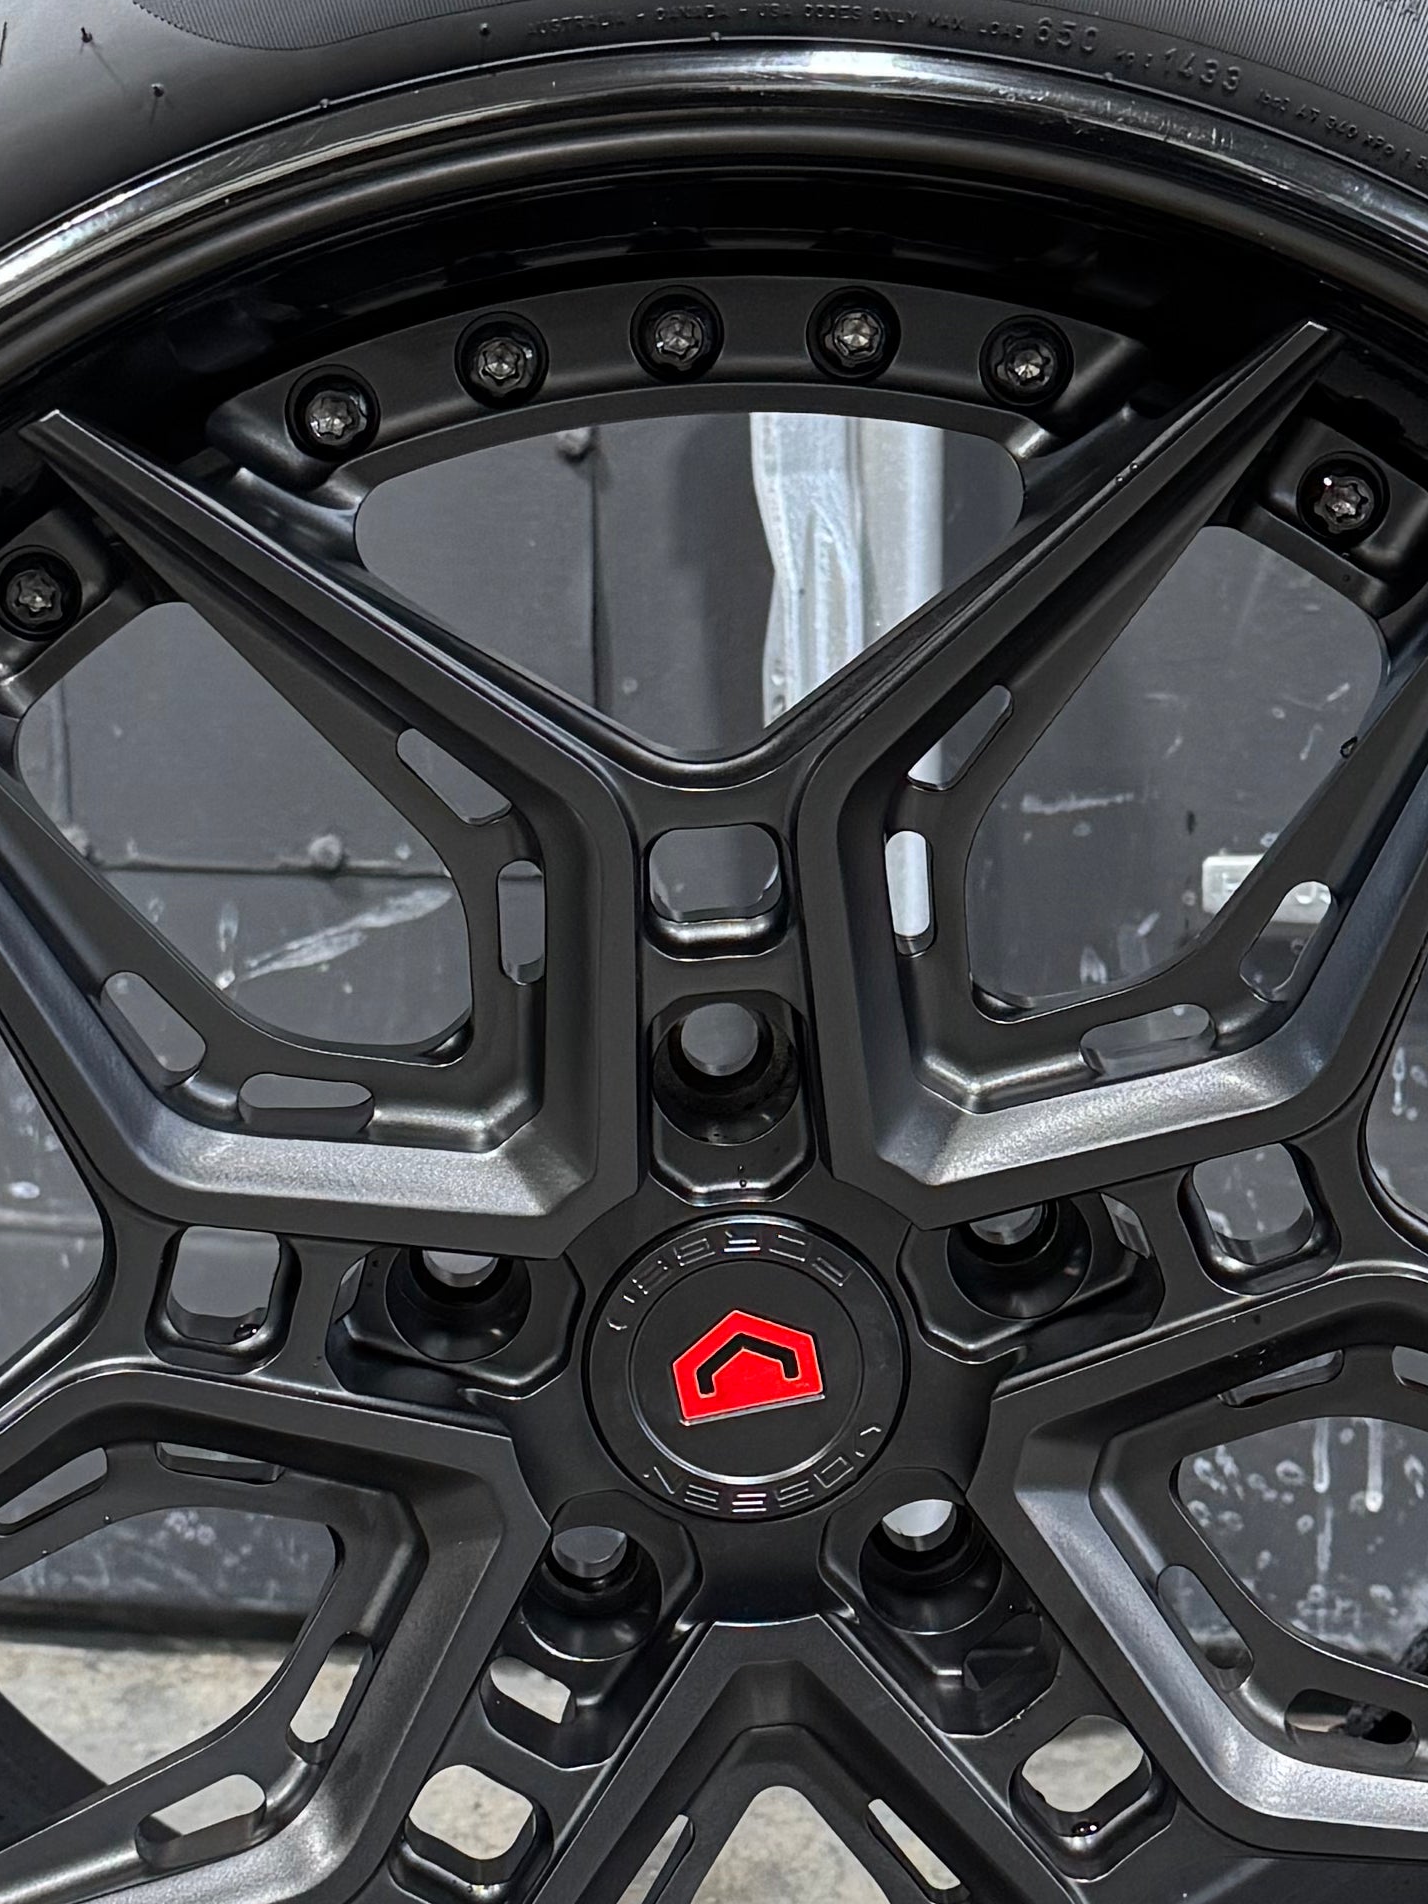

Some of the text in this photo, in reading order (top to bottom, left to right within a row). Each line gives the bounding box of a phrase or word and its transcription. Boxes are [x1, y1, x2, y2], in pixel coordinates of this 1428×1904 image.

[1033, 14, 1098, 52] 650
[1159, 44, 1242, 95] 1433
[641, 1425, 882, 1514] VOSSEN
